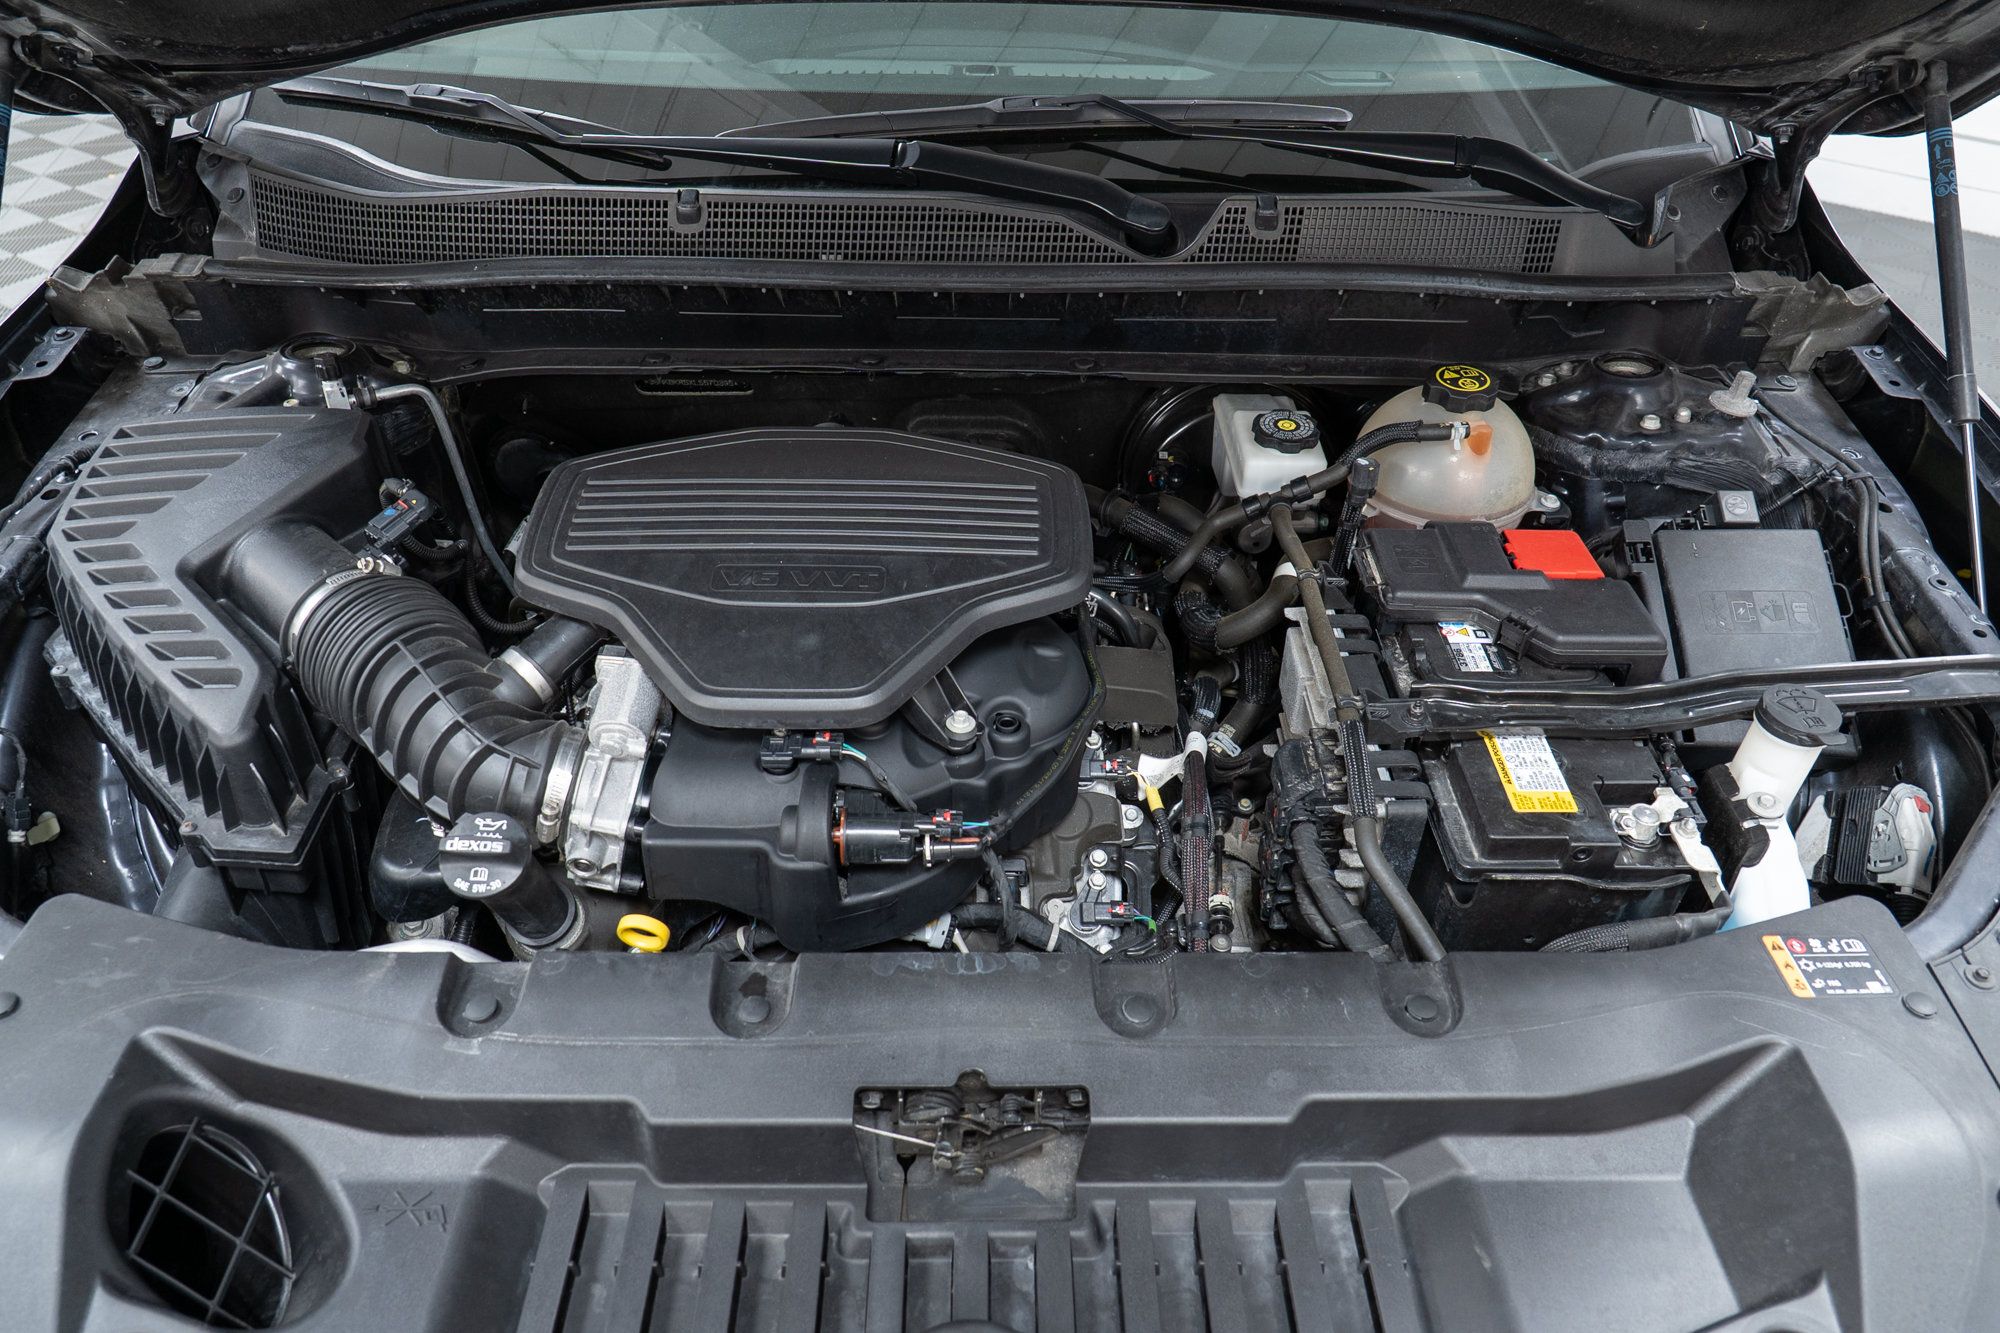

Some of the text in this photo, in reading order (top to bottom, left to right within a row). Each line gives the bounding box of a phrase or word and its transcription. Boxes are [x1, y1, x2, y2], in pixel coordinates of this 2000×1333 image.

[720, 569, 879, 588] V6 VVT
[1496, 757, 1511, 779] DANGER
[445, 837, 504, 853] dexos
[453, 877, 502, 893] SAE 5W-30
